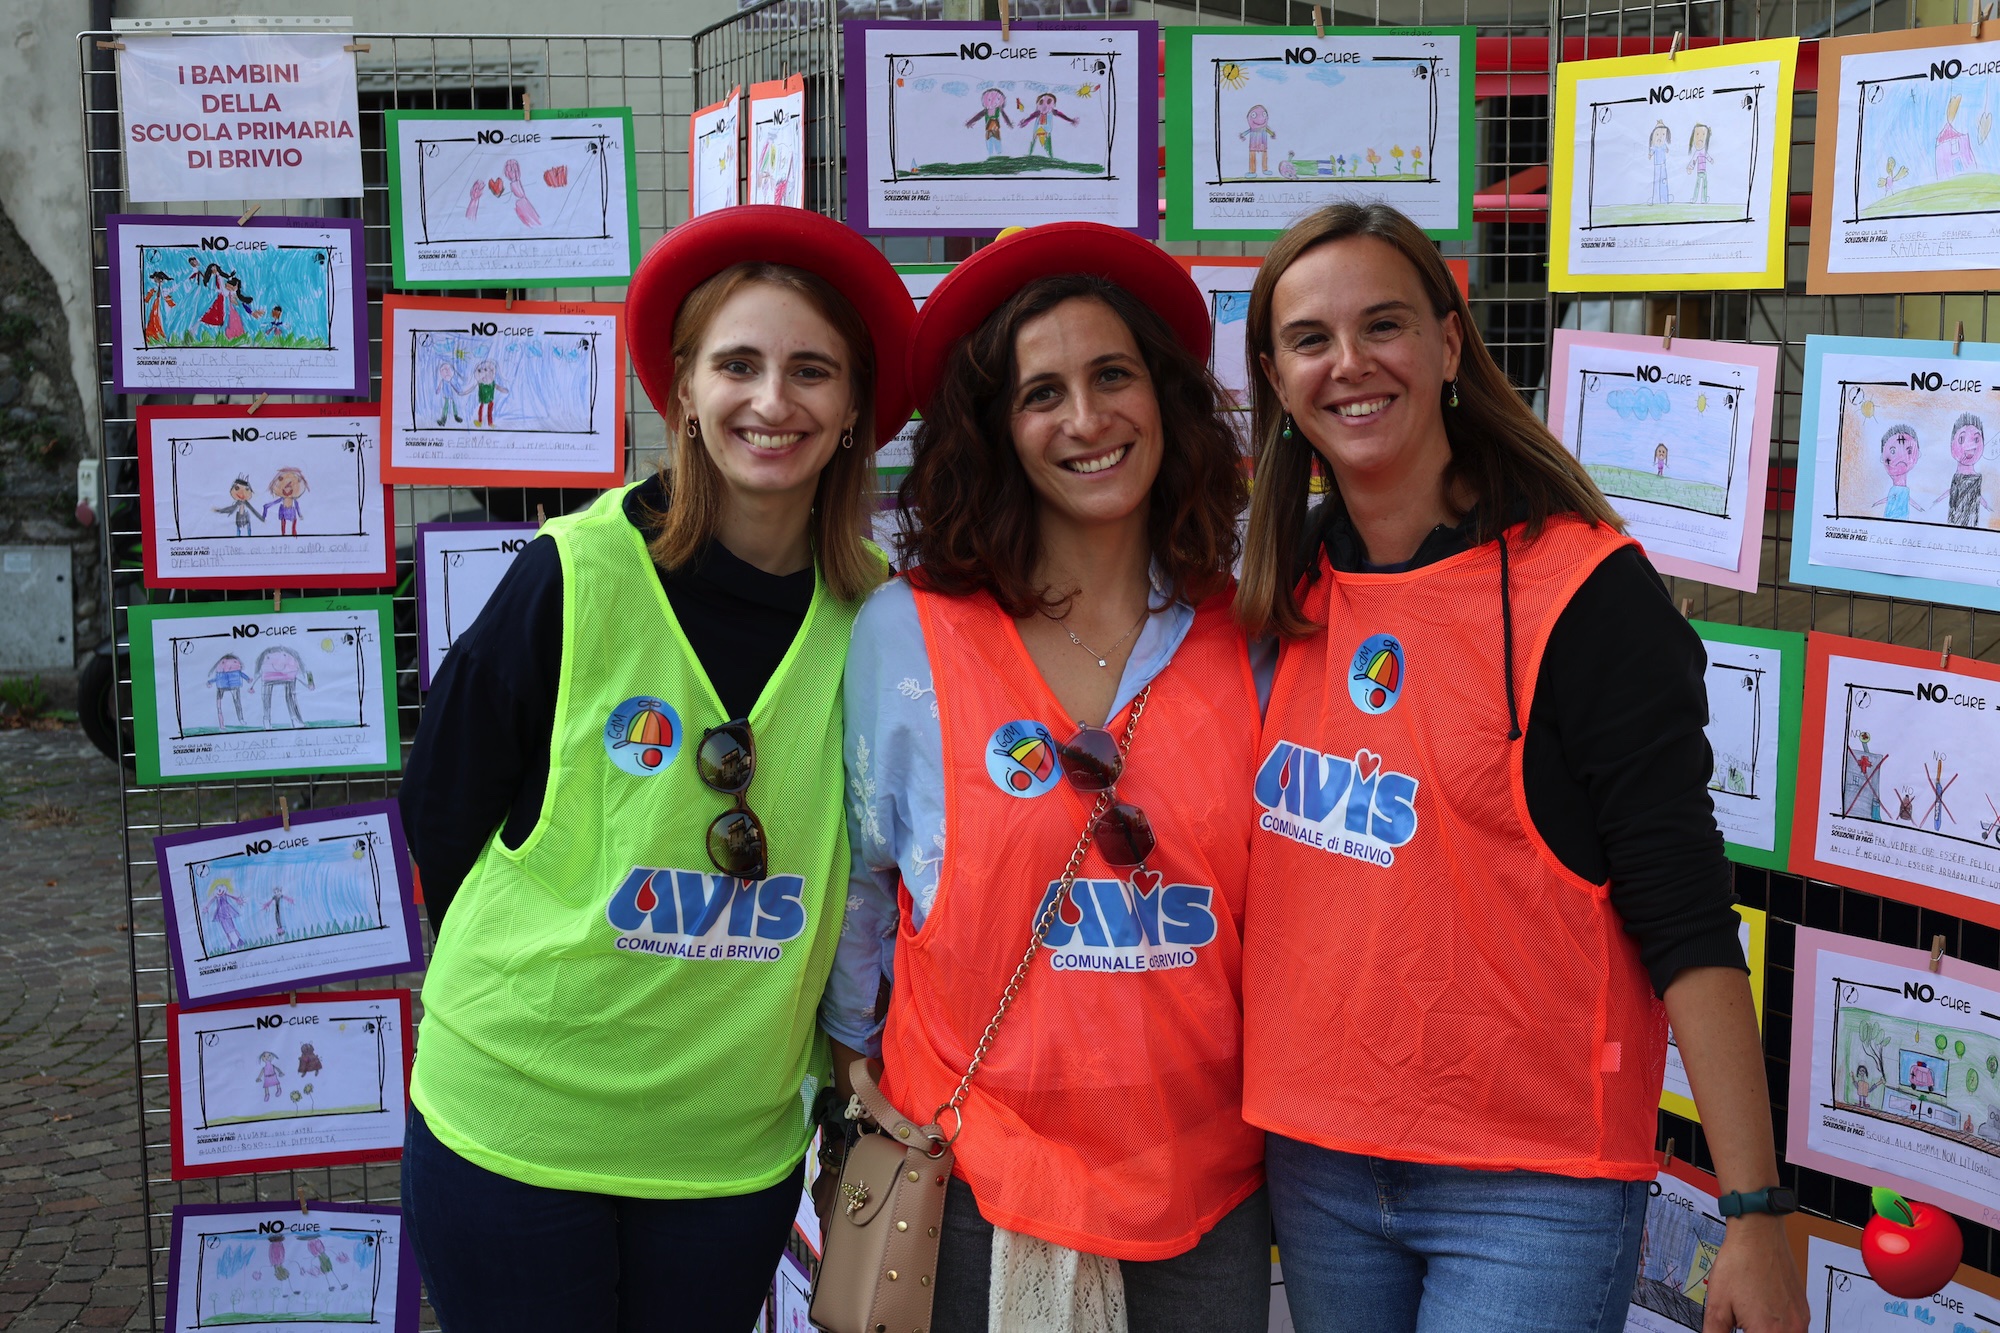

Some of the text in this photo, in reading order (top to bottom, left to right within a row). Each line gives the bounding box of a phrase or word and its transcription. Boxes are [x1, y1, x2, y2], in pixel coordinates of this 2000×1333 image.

[960, 42, 1038, 60] NO-CURE
[1285, 47, 1361, 64] NO-CURE
[179, 63, 300, 85] I BAMBINI
[202, 93, 281, 113] DELLA
[1649, 85, 1705, 104] NO-CURE
[131, 120, 354, 142] SCUOLA PRIMARIA
[477, 130, 541, 144] NO-CURE
[188, 148, 302, 169] DI BRIVIO
[201, 236, 268, 251] NO-CURE
[471, 322, 534, 337] NO-CURE
[1636, 365, 1692, 386] NO-CURE
[1910, 372, 1982, 392] NO-CURE
[232, 428, 297, 442] NO-CURE
[232, 624, 297, 639] NO-CURE
[1916, 682, 1986, 710] NO-CURE
[1932, 750, 1947, 761] NO
[246, 837, 310, 857] NO-CURE
[1262, 815, 1392, 865] COMUNALE di BRIVIO
[616, 937, 780, 960] COMUNALE di BRIVIO
[1053, 954, 1145, 969] COMUNALE
[1904, 982, 1971, 1014] NO-CURE
[256, 1014, 319, 1029] NO-CURE
[1941, 1149, 1956, 1165] NON
[1649, 1180, 1695, 1213] O-CURE
[258, 1220, 320, 1234] NO-CURE
[1928, 1291, 1965, 1315] -CURE
